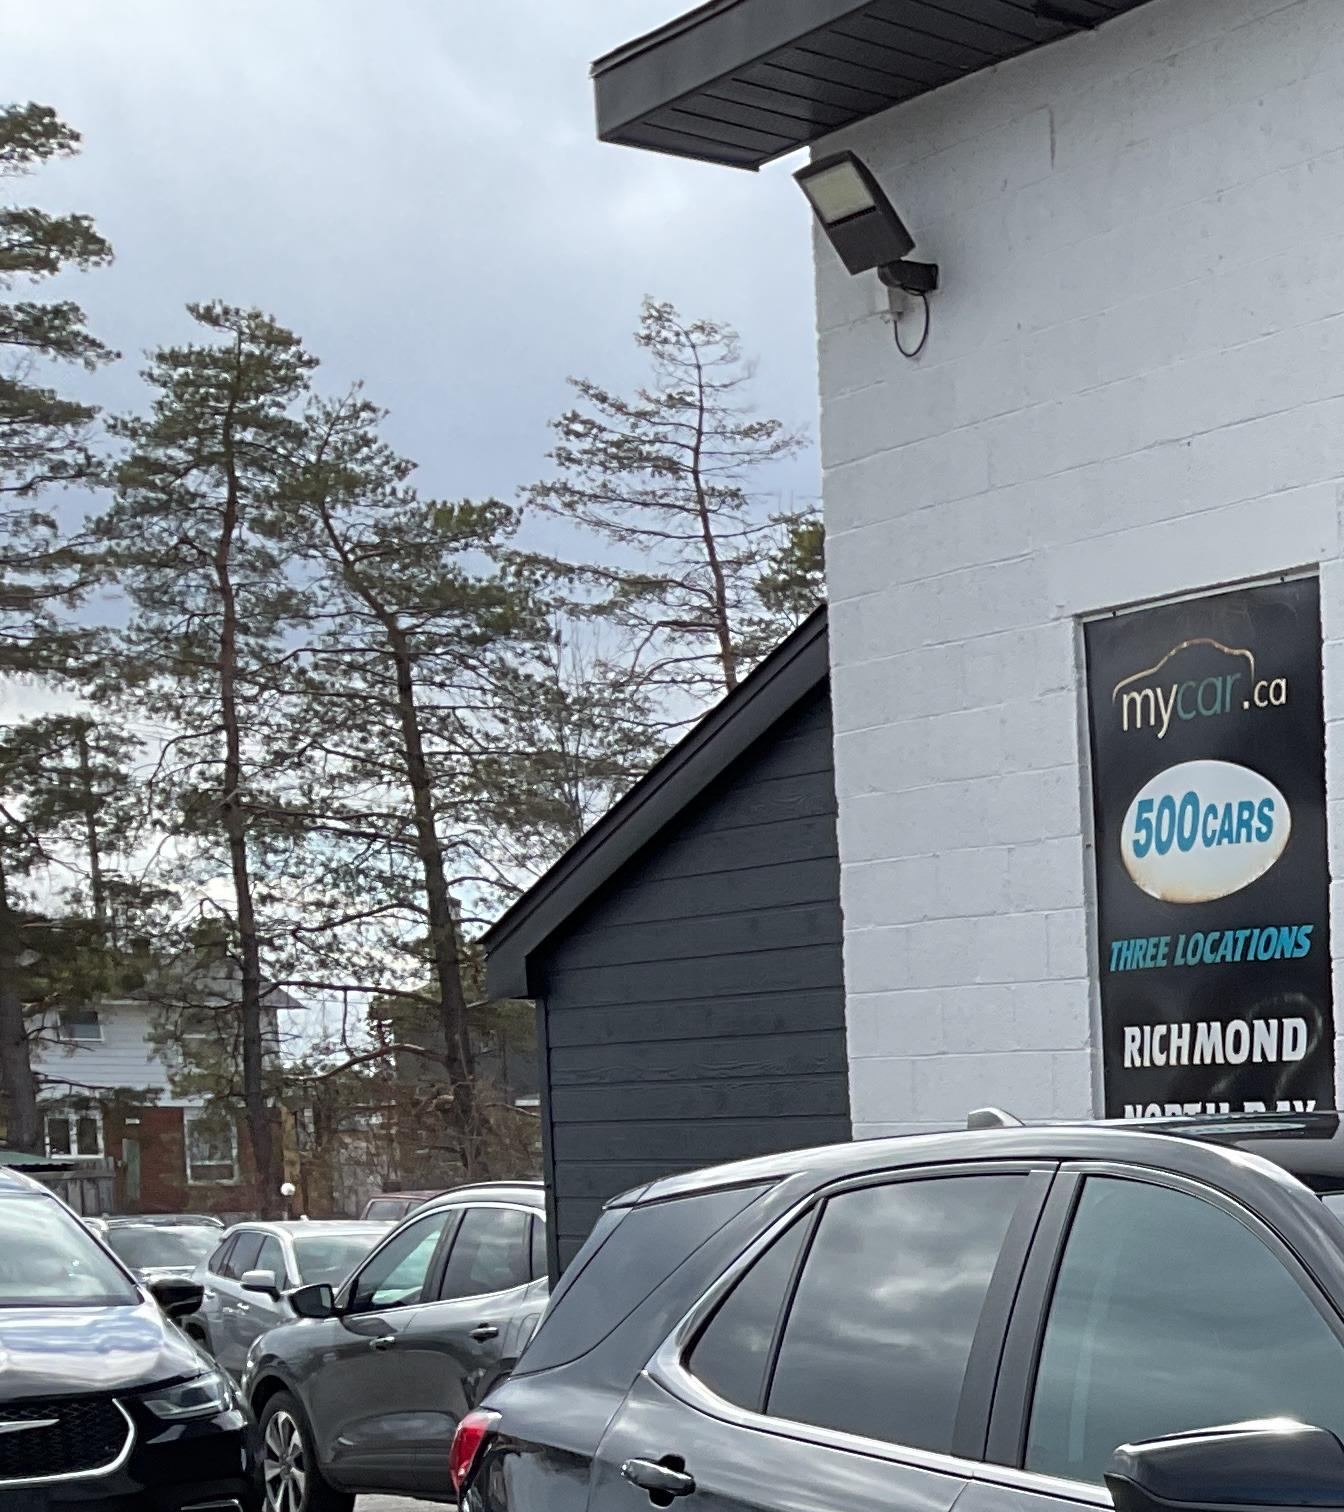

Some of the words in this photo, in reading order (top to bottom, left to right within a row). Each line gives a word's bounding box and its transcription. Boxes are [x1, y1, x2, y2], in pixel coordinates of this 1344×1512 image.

[1123, 672, 1287, 739] mycar.ca
[1109, 935, 1173, 972] THREE
[1173, 924, 1314, 967] LOCATIONS
[1123, 1017, 1308, 1068] RICHMOND
